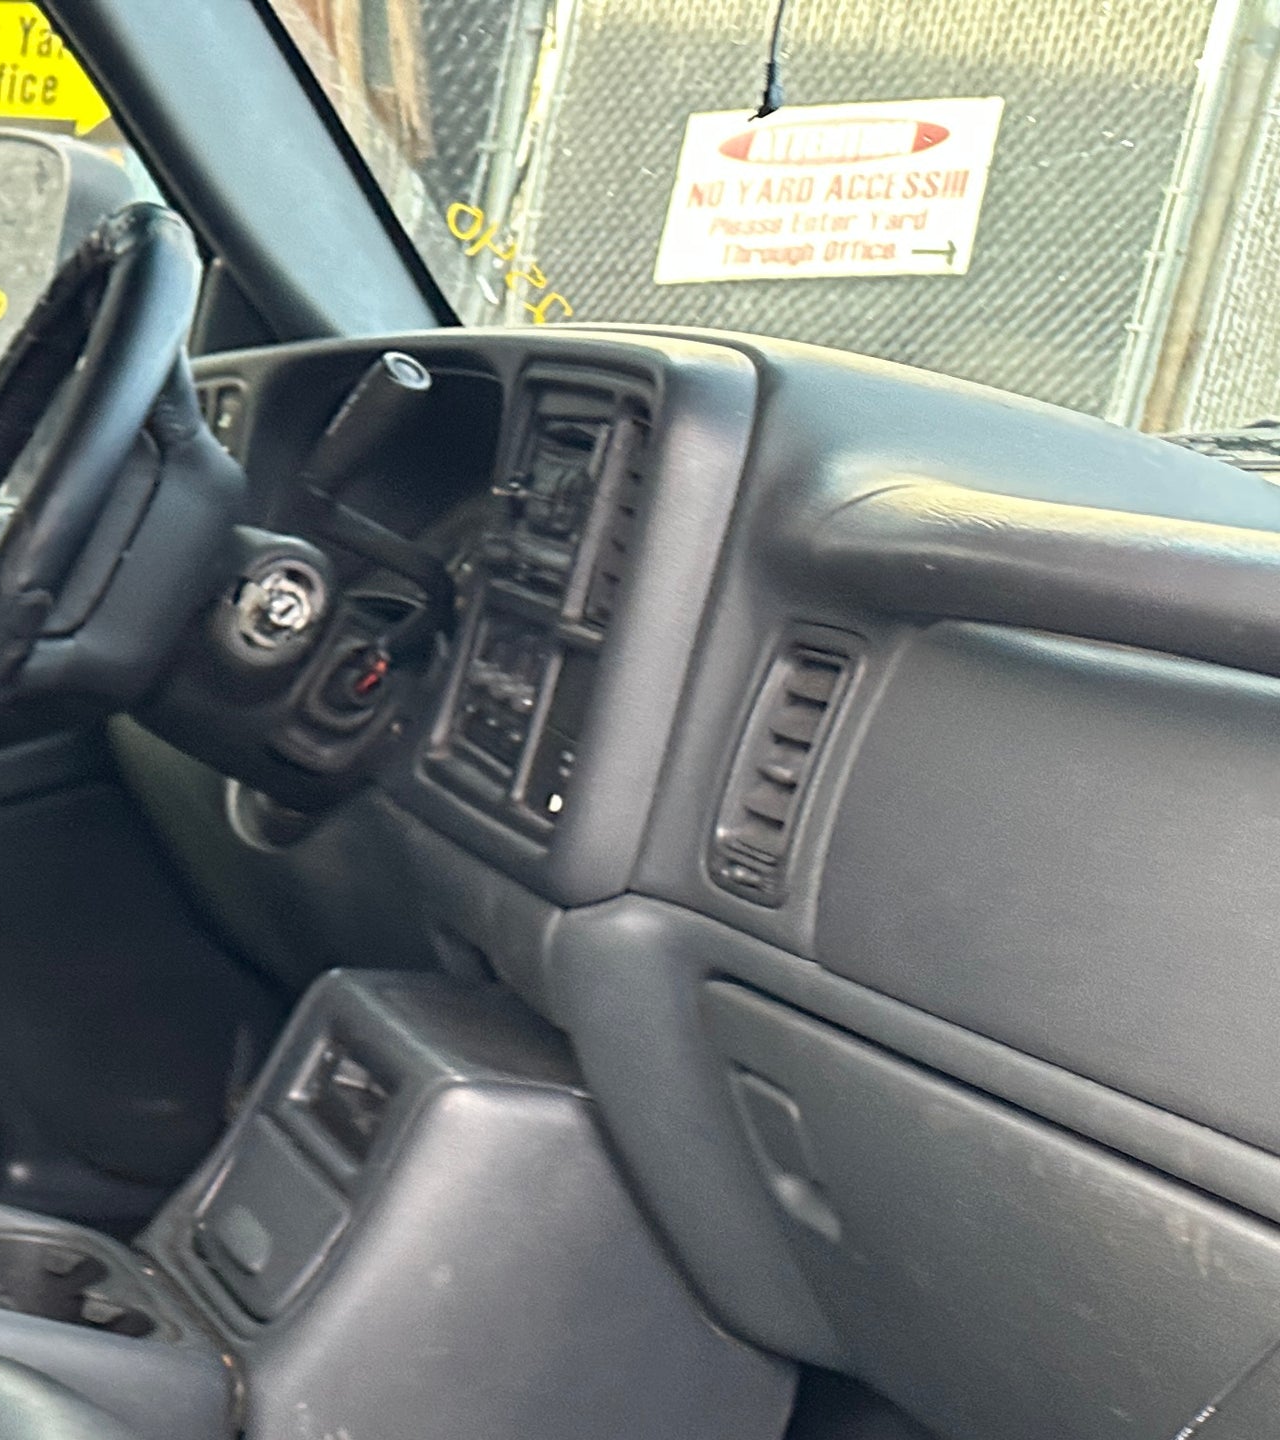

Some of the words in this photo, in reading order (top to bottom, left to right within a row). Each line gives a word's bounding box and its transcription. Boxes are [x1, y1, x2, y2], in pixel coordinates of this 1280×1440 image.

[687, 181, 726, 208] NO
[738, 176, 814, 206] YARD
[871, 208, 929, 231] Yard
[722, 241, 815, 267] Through
[823, 239, 897, 263] Office
